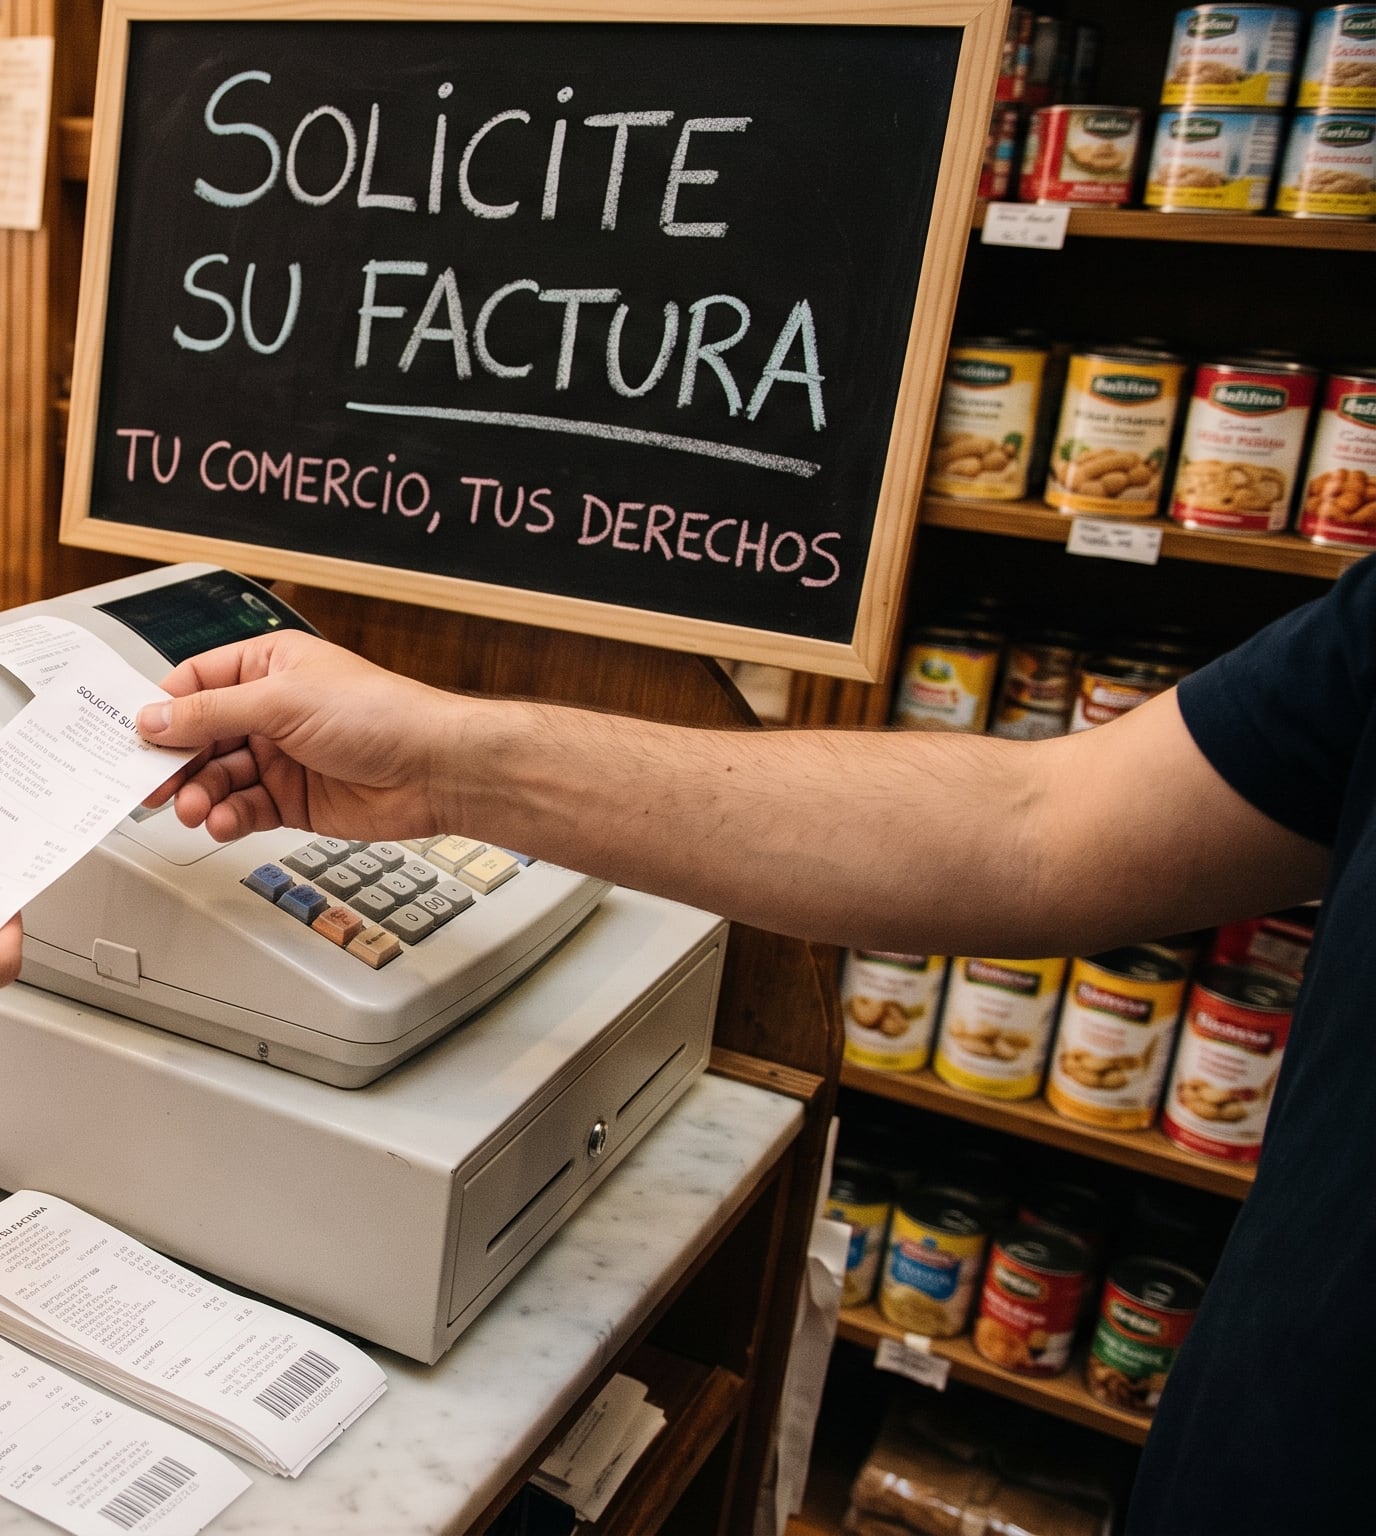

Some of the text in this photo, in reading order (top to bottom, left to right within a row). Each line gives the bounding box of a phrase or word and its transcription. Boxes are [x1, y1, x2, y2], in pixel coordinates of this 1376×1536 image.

[194, 70, 753, 238] SOLICITE
[173, 253, 827, 431] SU FACTURA
[116, 428, 841, 588] TU COMERCIO, TUS DERECHOS
